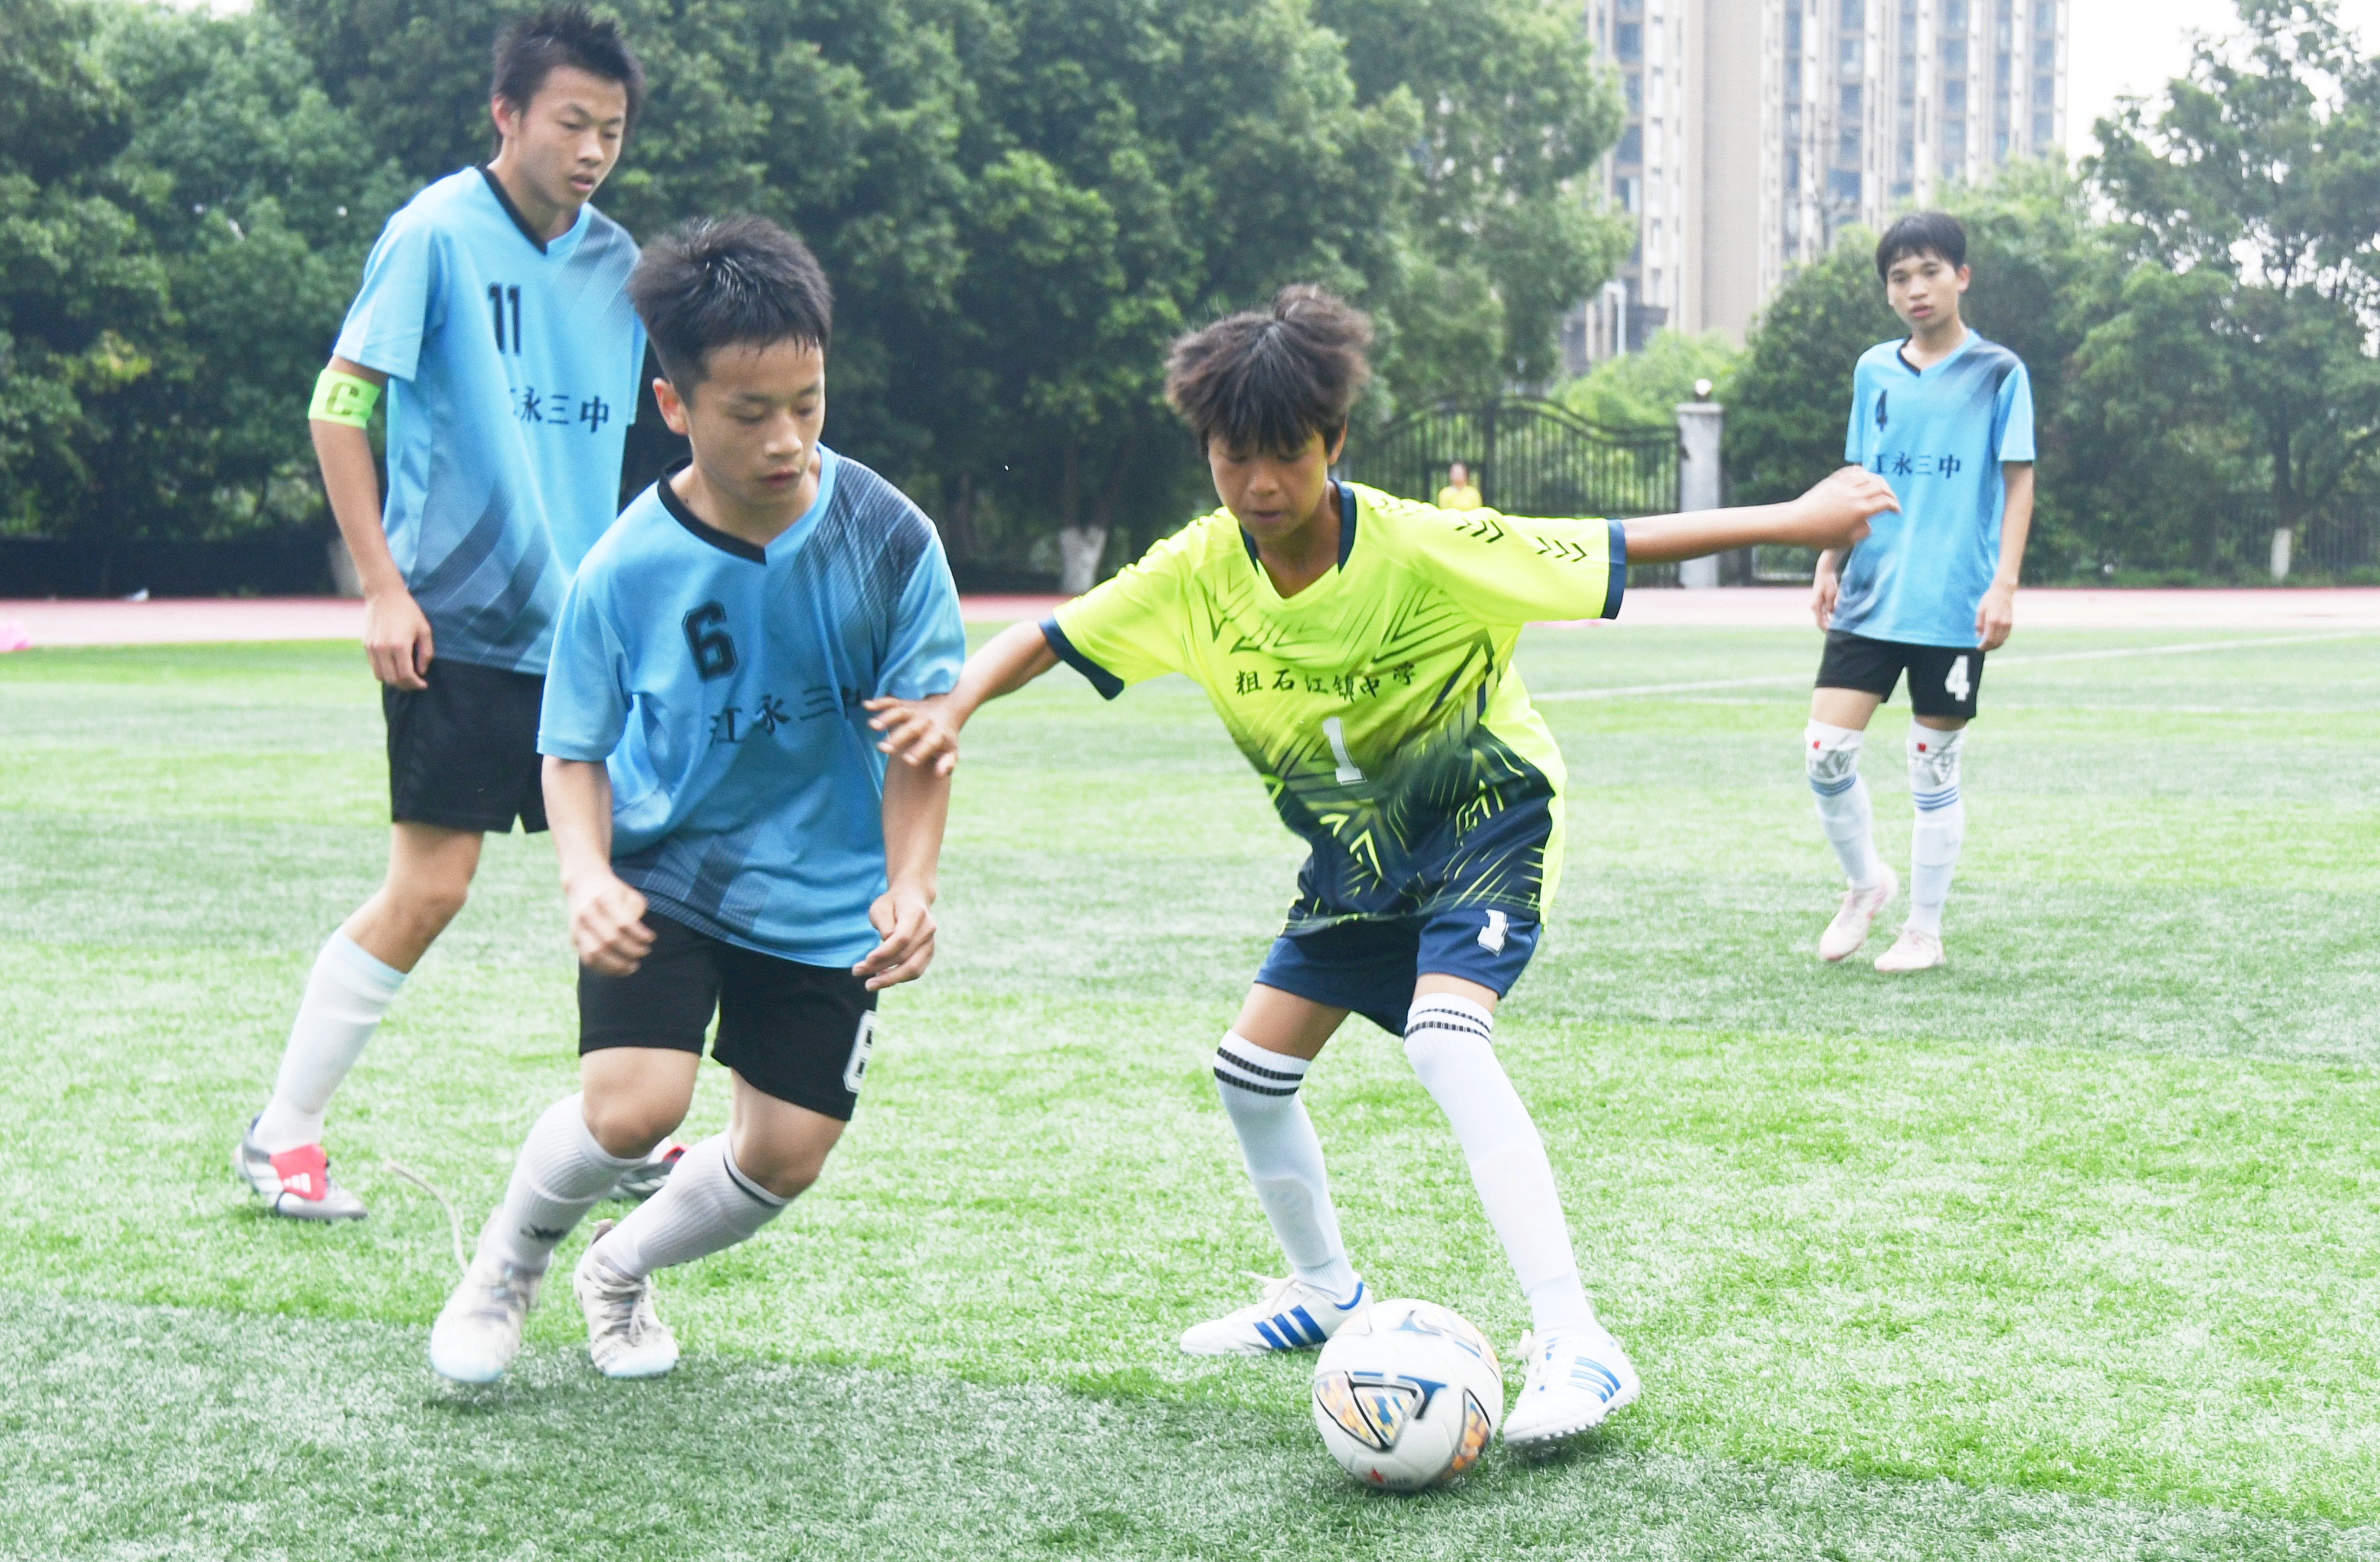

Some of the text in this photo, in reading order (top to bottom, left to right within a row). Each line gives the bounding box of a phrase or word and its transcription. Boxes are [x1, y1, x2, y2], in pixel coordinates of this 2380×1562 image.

[488, 281, 521, 356] 11
[324, 382, 360, 416] C
[509, 384, 610, 434] 永三中
[681, 599, 739, 683] 6
[1944, 654, 1970, 702] 4
[1322, 716, 1368, 785] 1
[1477, 908, 1509, 957] 1
